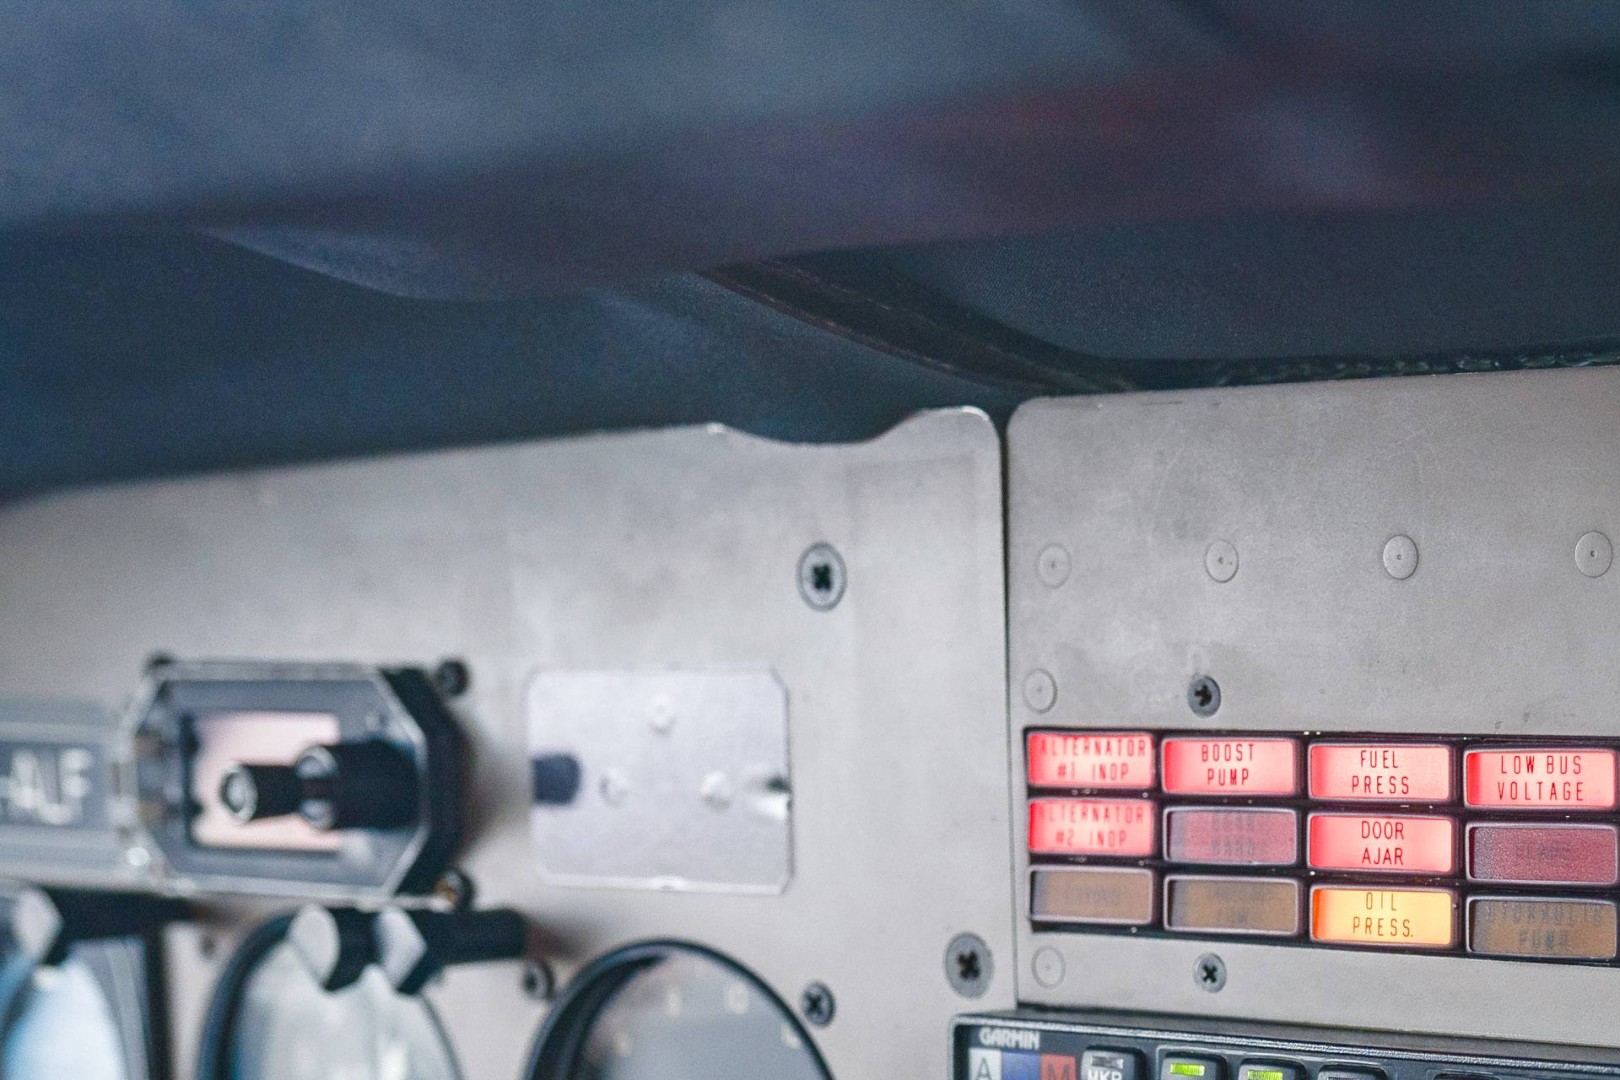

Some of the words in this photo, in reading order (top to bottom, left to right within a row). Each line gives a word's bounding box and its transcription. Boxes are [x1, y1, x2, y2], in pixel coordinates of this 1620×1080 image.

[1040, 737, 1146, 758] ALTERNATOR
[1201, 743, 1255, 763] BOOST
[1360, 749, 1400, 770] FUEL
[1500, 755, 1535, 775] LOW
[1545, 756, 1582, 777] BUS
[1058, 762, 1076, 781] #1
[1091, 762, 1129, 782] INOP
[1206, 767, 1250, 787] PUMP
[1351, 775, 1410, 795] PRESS
[1497, 780, 1585, 802] VOLTAGE
[1038, 803, 1144, 825] ALTERNATOR
[1055, 829, 1076, 848] #2
[1089, 829, 1128, 849] INOP
[1360, 820, 1405, 841] DOOR
[1361, 847, 1405, 866] AJAR
[1365, 891, 1398, 912] OIL
[1352, 916, 1414, 938] PRESS.
[979, 1027, 1041, 1050] GARMIN
